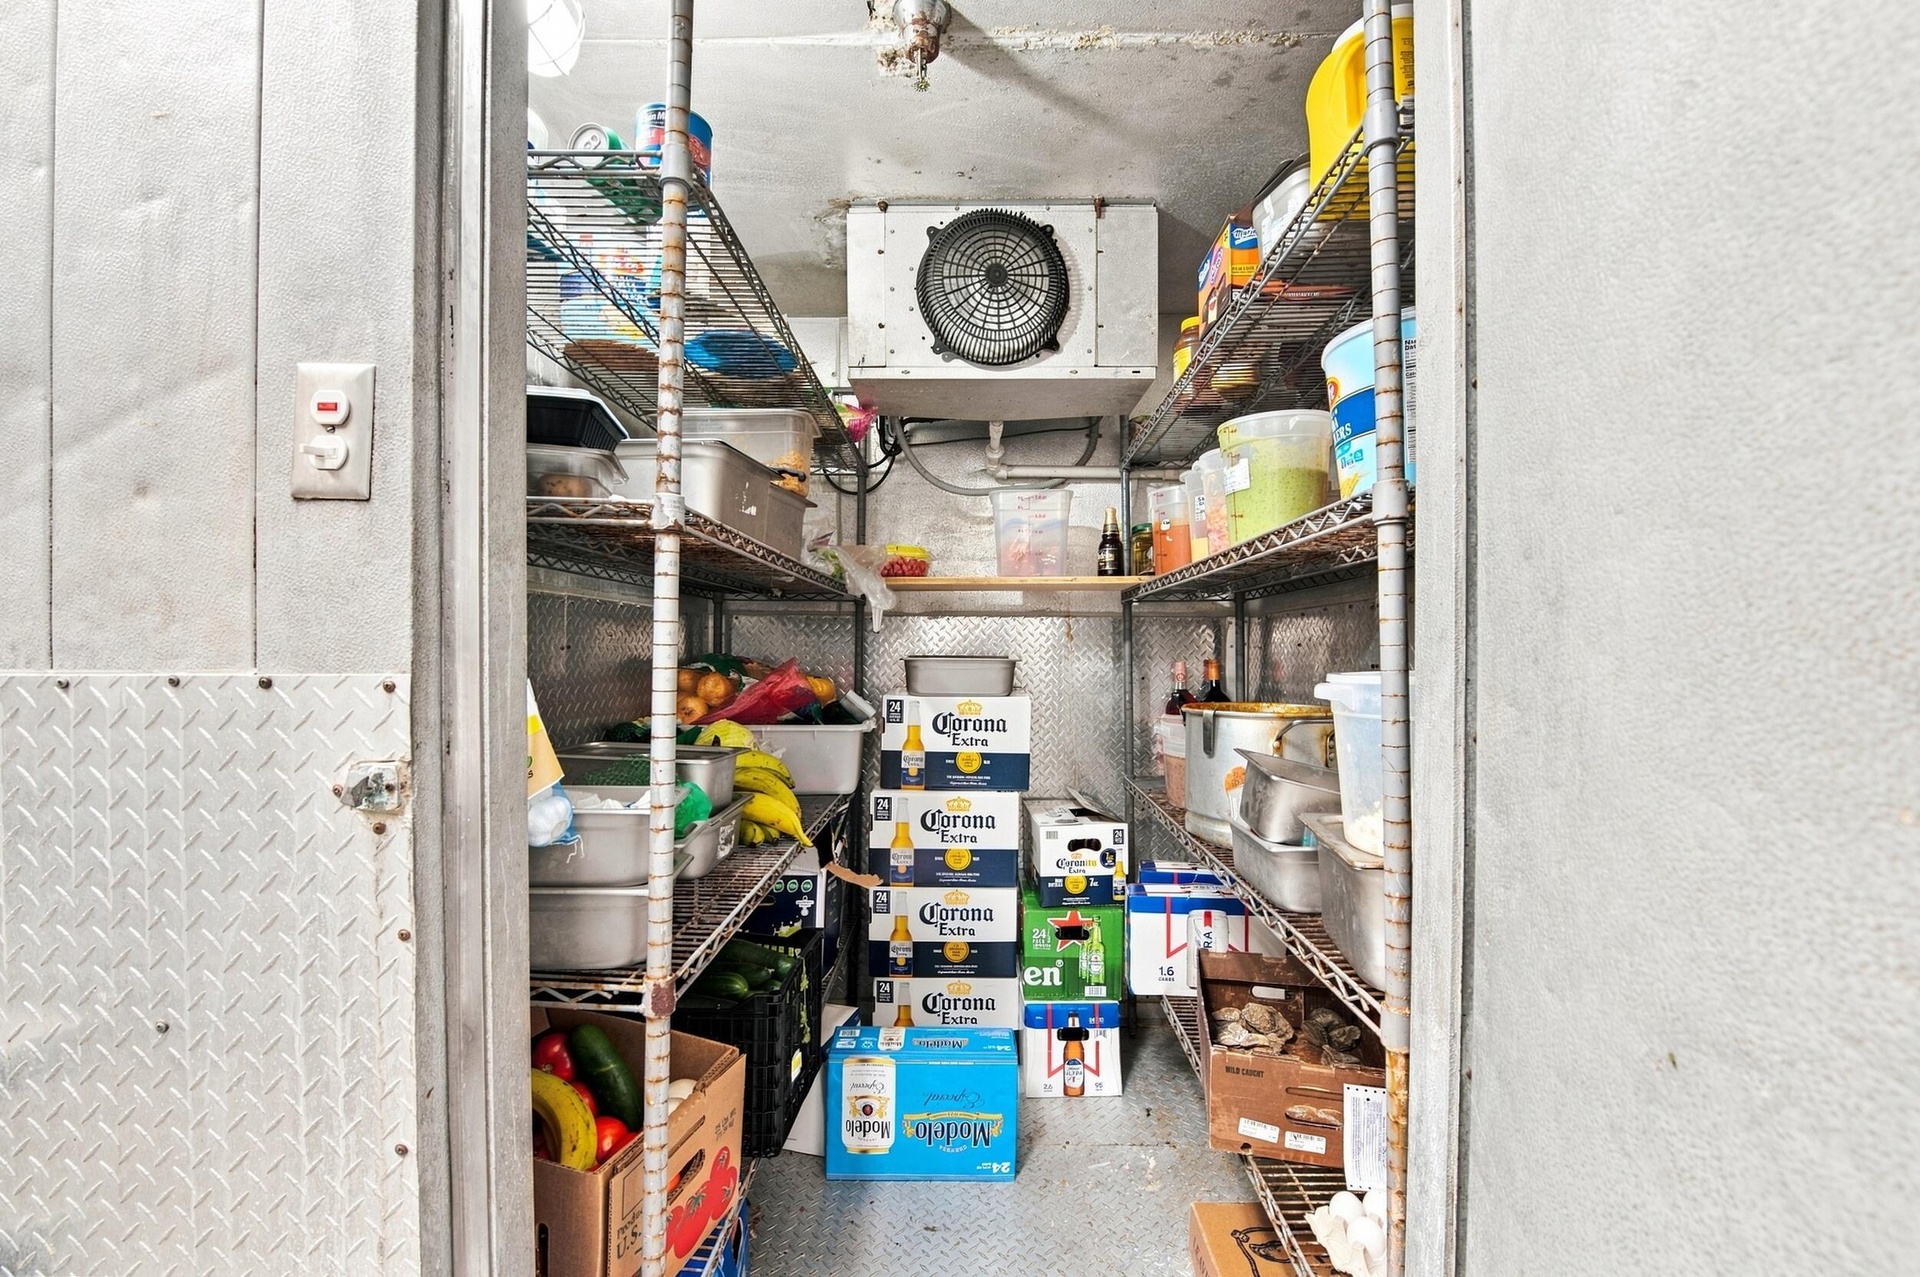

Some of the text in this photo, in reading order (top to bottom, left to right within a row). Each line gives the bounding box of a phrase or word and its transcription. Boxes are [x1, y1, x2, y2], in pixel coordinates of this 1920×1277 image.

[889, 701, 901, 713] 24
[932, 712, 1008, 738] Corona
[951, 733, 989, 747] Extra
[877, 798, 889, 810] 24
[920, 808, 996, 835] Corona
[940, 830, 978, 843] Extra
[876, 891, 888, 903] 24
[919, 902, 995, 928] Corona
[939, 923, 976, 936] Extra
[1032, 928, 1046, 939] 24
[1158, 966, 1175, 976] 1.6
[879, 982, 891, 993] 24
[921, 992, 996, 1017] Corona
[941, 1012, 978, 1025] Extra
[1225, 1066, 1265, 1078] WILD CAUGHT
[845, 1119, 891, 1139] Modelo
[915, 1121, 993, 1148] Modelo
[991, 1161, 1011, 1173] 24
